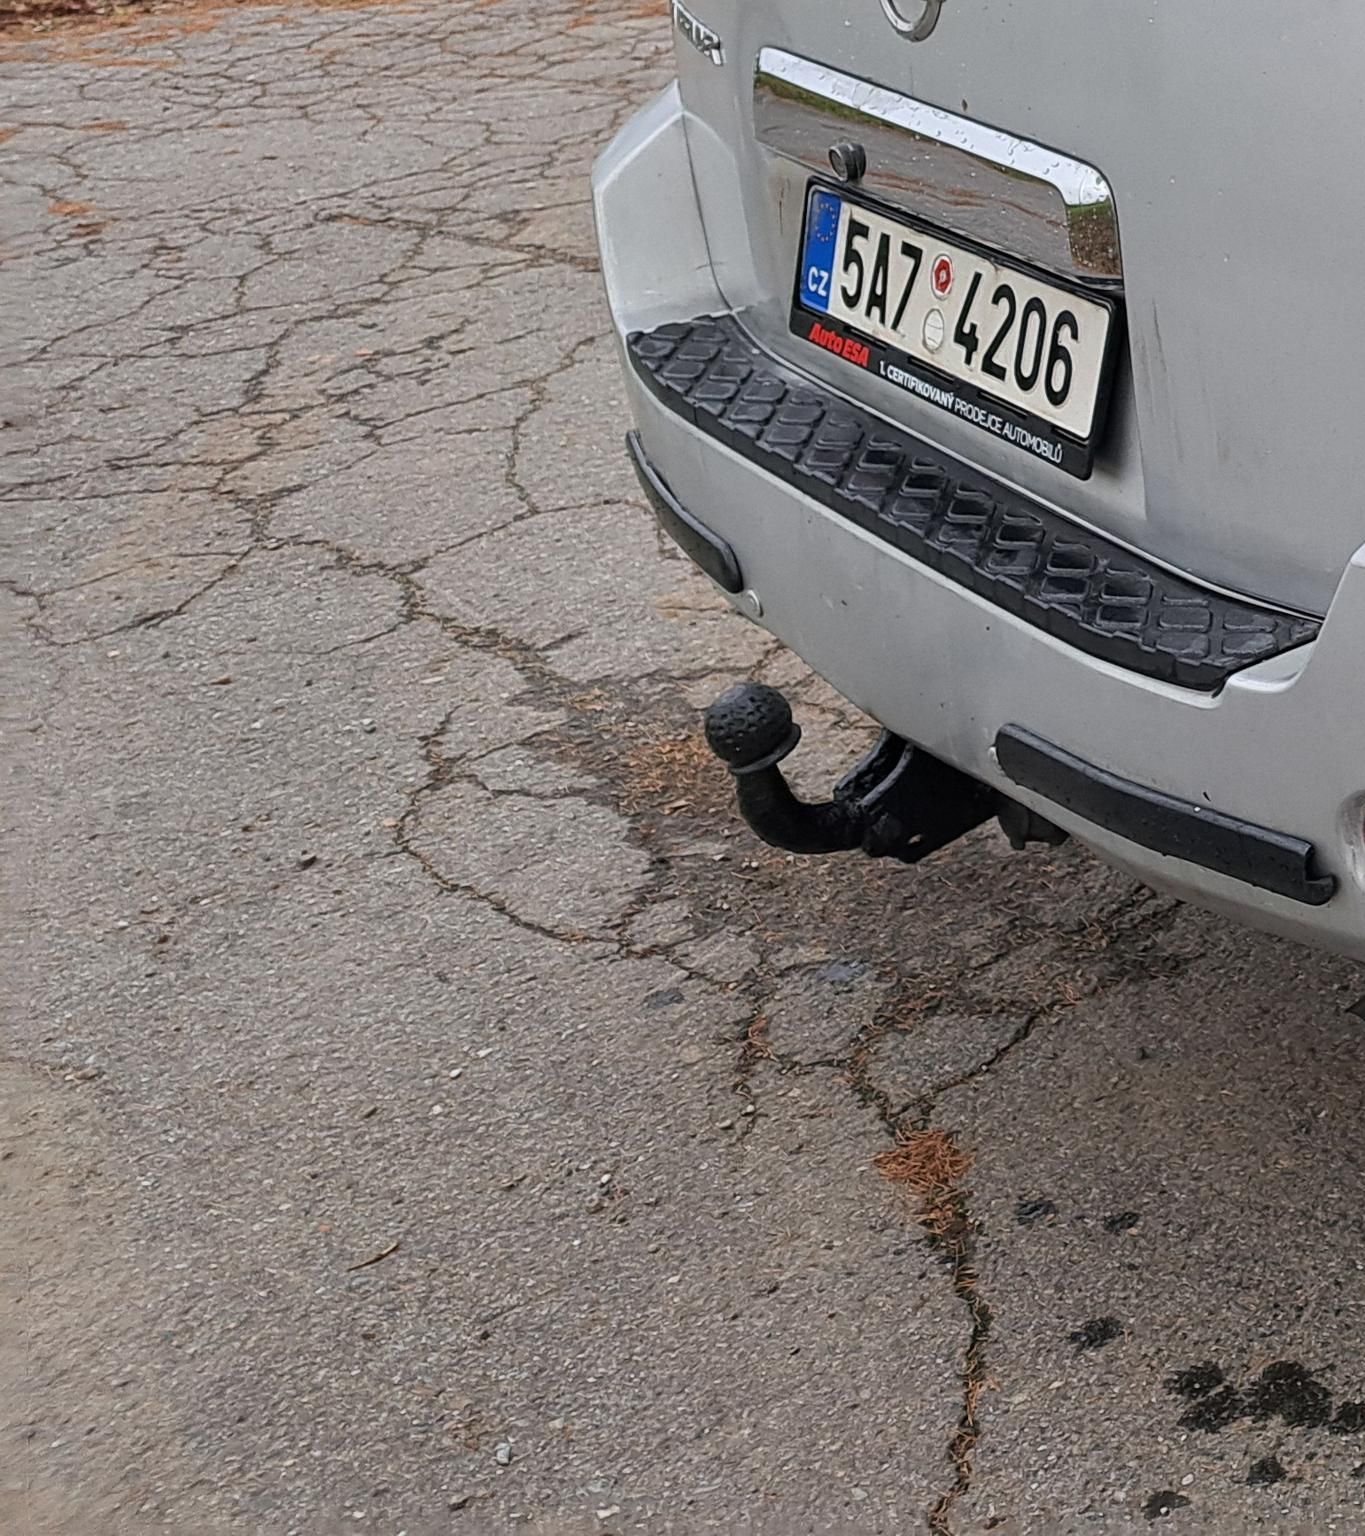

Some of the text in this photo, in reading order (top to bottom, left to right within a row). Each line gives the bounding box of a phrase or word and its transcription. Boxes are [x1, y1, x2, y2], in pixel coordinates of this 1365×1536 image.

[807, 266, 830, 297] CZ
[840, 218, 1080, 407] 5A7 4206
[808, 322, 870, 368] Auto ESA
[887, 364, 956, 412] CERTIFIKOVANÝ
[954, 396, 1002, 434] PRODEJCE
[1002, 417, 1064, 464] AUTOMOBILŮ
